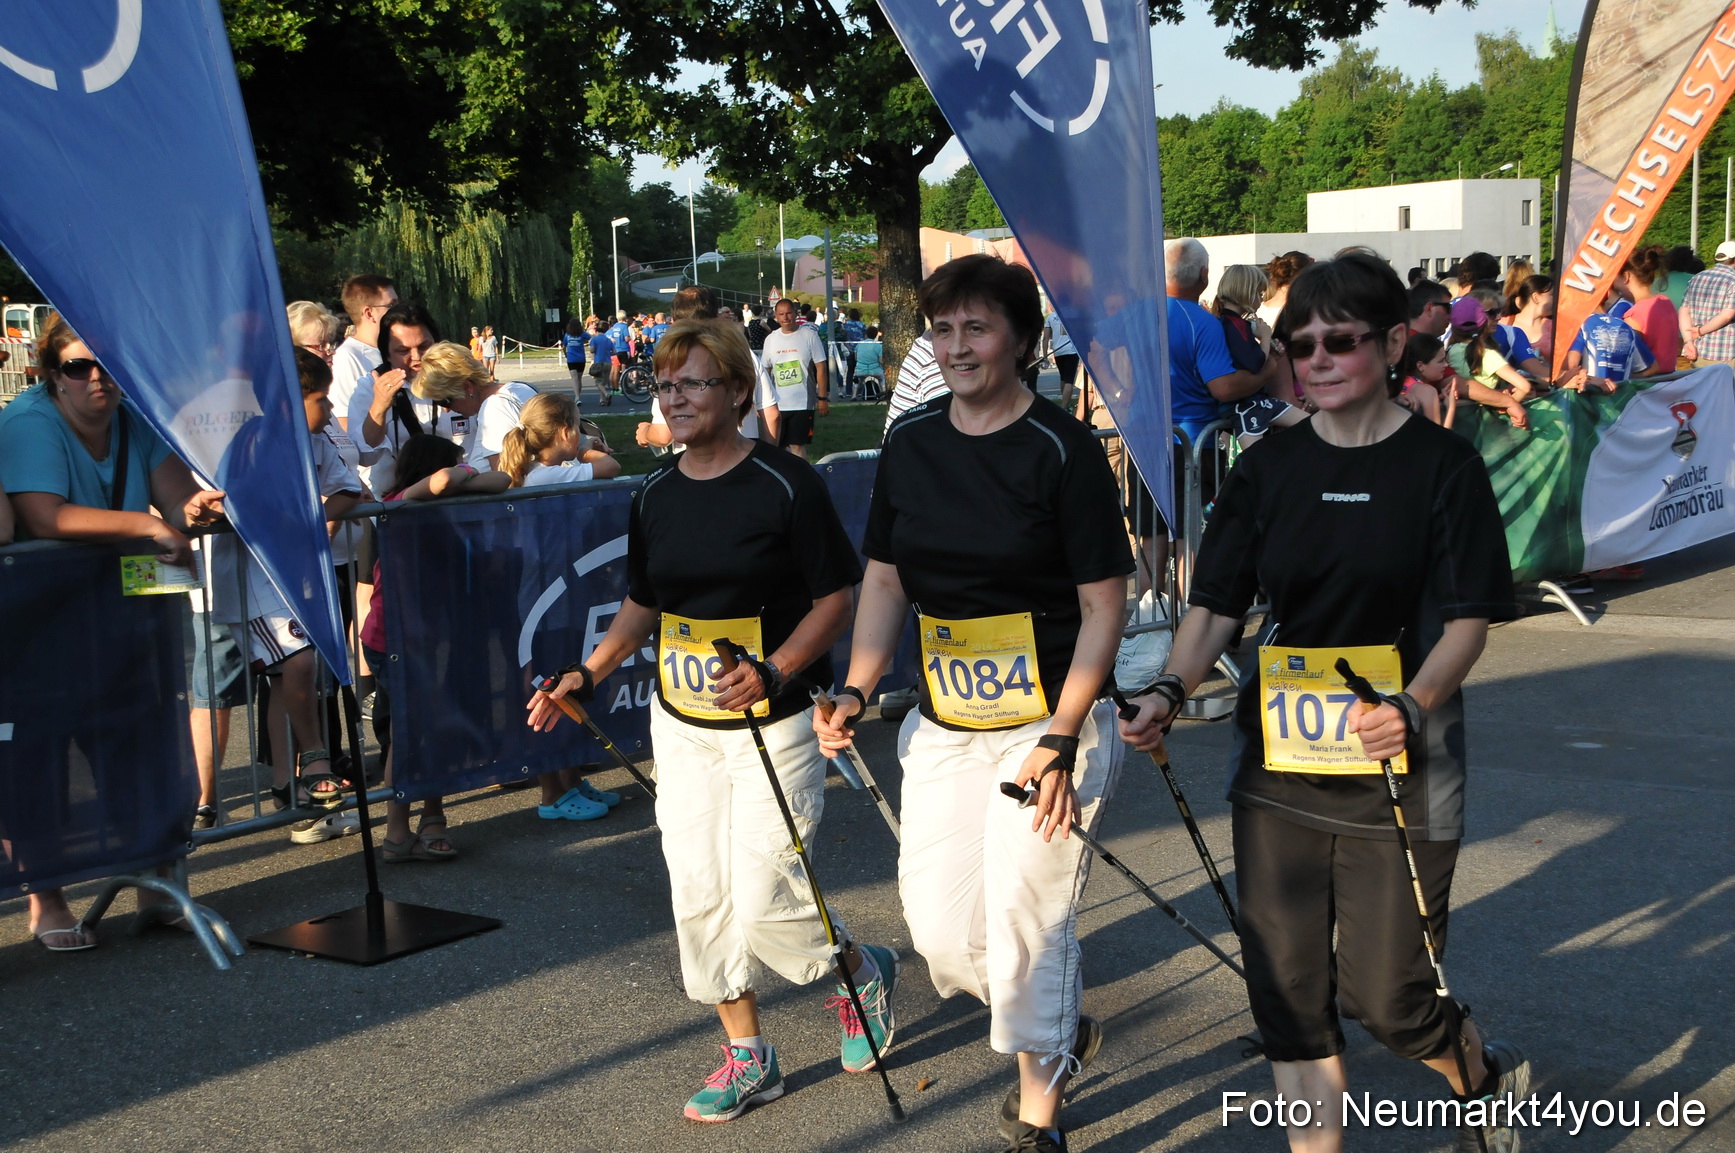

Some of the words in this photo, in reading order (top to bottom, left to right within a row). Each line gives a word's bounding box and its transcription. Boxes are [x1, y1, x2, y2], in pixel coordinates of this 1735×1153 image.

[1563, 8, 1735, 293] WECHSELSZE
[779, 369, 797, 380] 524
[908, 404, 928, 414] JAKO
[1321, 492, 1370, 502] STANNO
[664, 652, 758, 694] 109
[928, 655, 1036, 700] 1084
[1279, 667, 1325, 680] firmenlauf
[1268, 681, 1303, 692] walken
[966, 703, 979, 711] Anna
[953, 709, 971, 718] Regens
[972, 712, 993, 720] Wagner
[994, 709, 1020, 718] Stiftung
[1267, 692, 1387, 742] 107
[1309, 744, 1328, 753] Maria
[1330, 745, 1352, 753] Frank
[1292, 753, 1316, 763] Regens
[1317, 755, 1342, 764] Wagner
[1344, 755, 1373, 764] Stiftung
